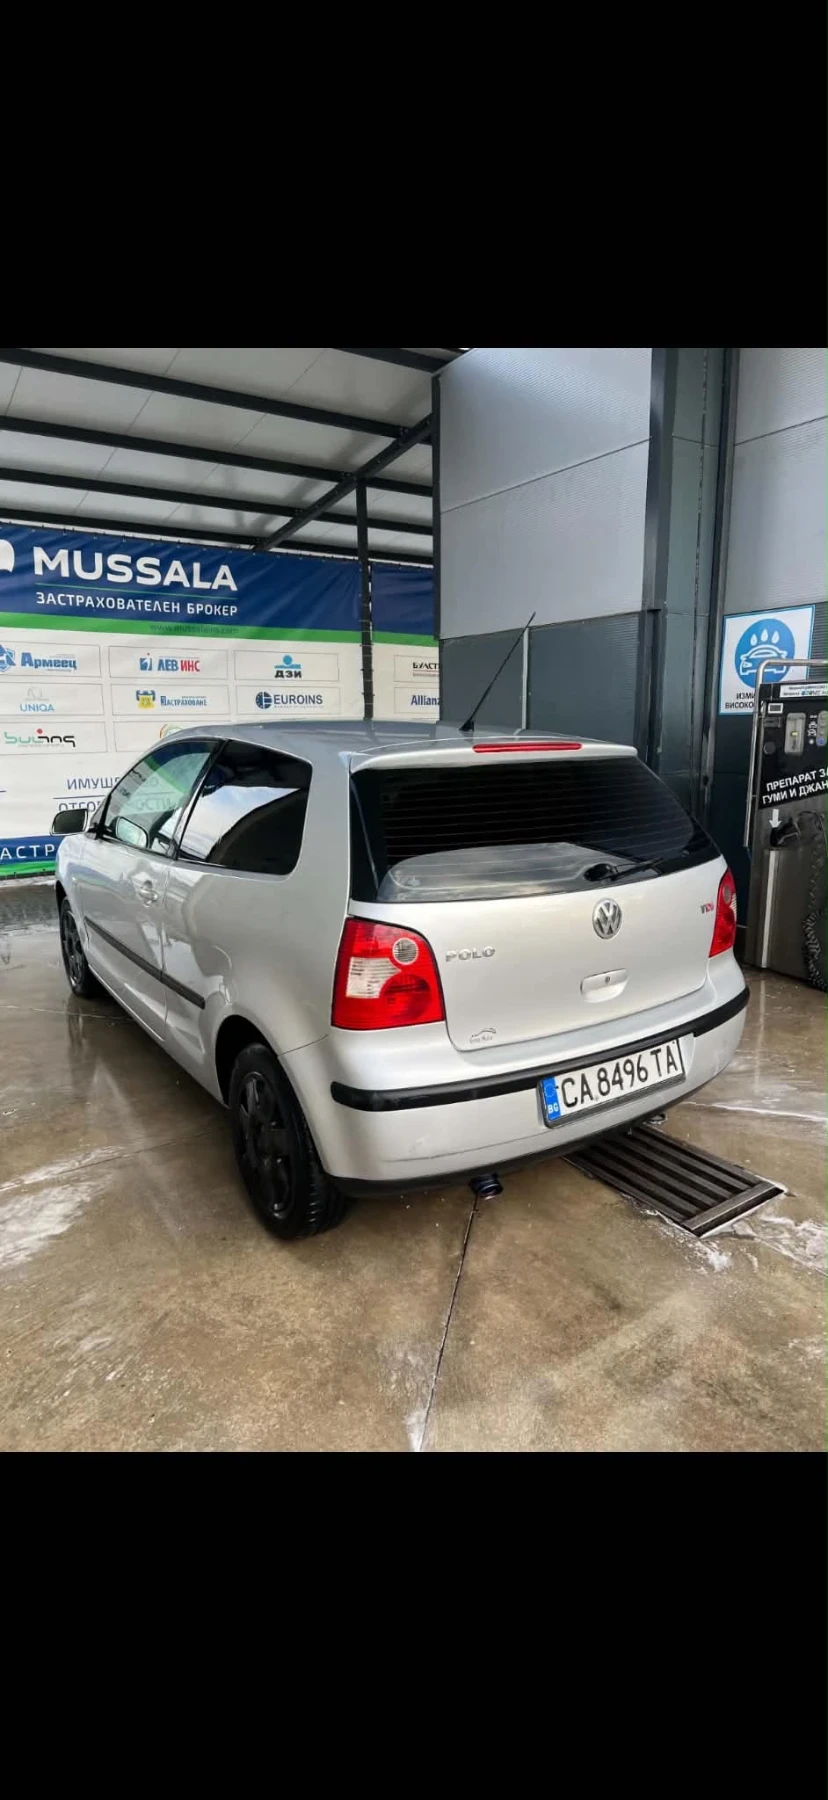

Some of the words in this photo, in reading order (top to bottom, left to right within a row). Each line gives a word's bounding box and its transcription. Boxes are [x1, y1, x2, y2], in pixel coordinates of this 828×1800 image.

[33, 546, 238, 591] MUSSALA
[36, 592, 180, 613] ЗАСТРАХОВАТЕЛЕН
[187, 603, 238, 616] БРОКЕР
[21, 652, 77, 670] Армеец
[157, 658, 179, 672] ЛЕВ
[180, 660, 200, 672] ИНС
[274, 670, 302, 679] ДЗИ
[20, 703, 55, 712] UNIQA
[273, 694, 324, 705] EUROINS
[766, 770, 817, 792] ПРЕПАРАТ
[762, 790, 788, 804] ГУМИ
[789, 787, 797, 798] И
[445, 946, 496, 962] POLO
[561, 1073, 594, 1108] CA
[597, 1054, 648, 1097] 8496
[650, 1045, 678, 1077] TA
[547, 1103, 559, 1113] BG
